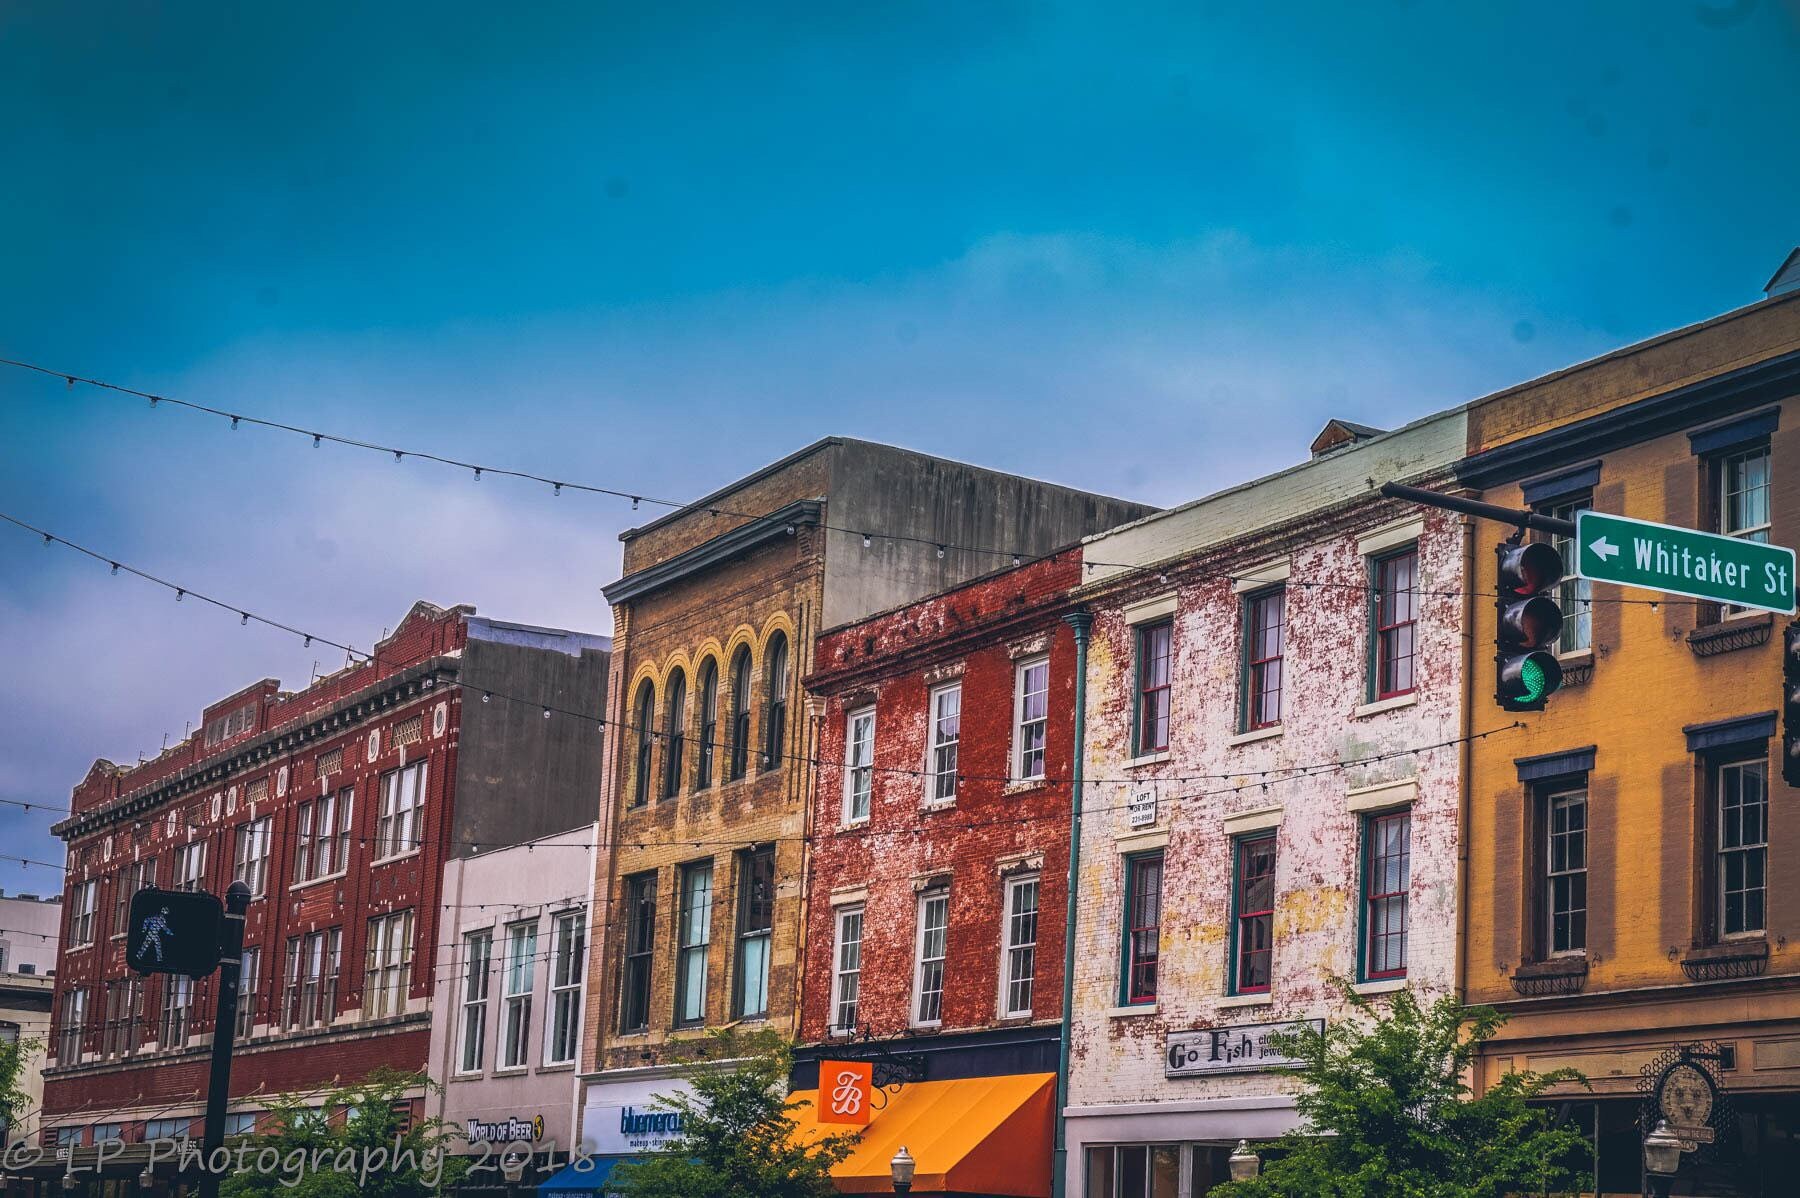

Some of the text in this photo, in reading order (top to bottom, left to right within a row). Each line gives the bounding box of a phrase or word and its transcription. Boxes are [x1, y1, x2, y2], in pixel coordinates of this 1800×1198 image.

[1633, 537, 1788, 597] Whitaker St
[1136, 792, 1151, 802] LOFT
[1141, 801, 1155, 811] RENT
[1258, 1032, 1298, 1046] cloing
[1168, 1030, 1253, 1069] Go Fish
[467, 1117, 533, 1143] WORLD OF BEER
